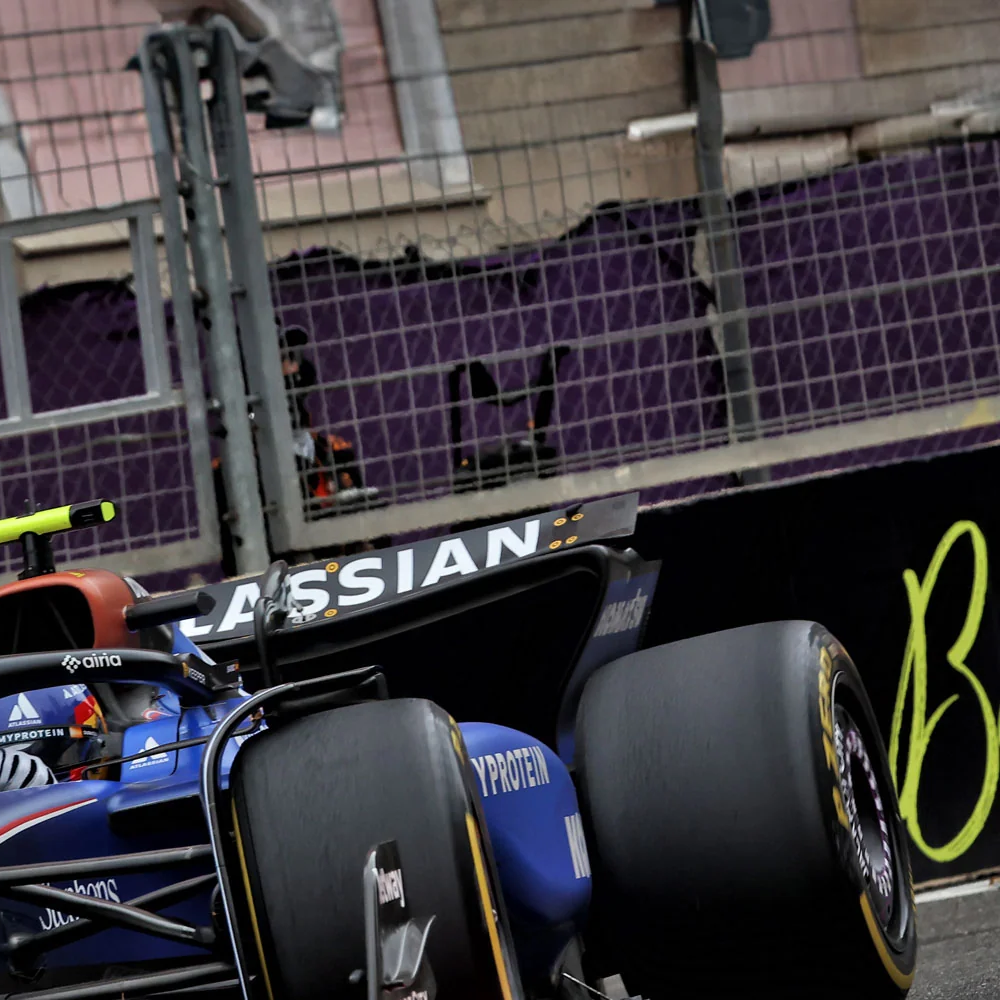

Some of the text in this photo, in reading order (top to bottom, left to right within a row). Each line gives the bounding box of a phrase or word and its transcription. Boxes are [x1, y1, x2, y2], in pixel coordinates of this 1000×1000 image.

[82, 652, 122, 669] airia
[8, 718, 42, 729] ATLASSIAN
[129, 757, 170, 770] ATLASSIAN
